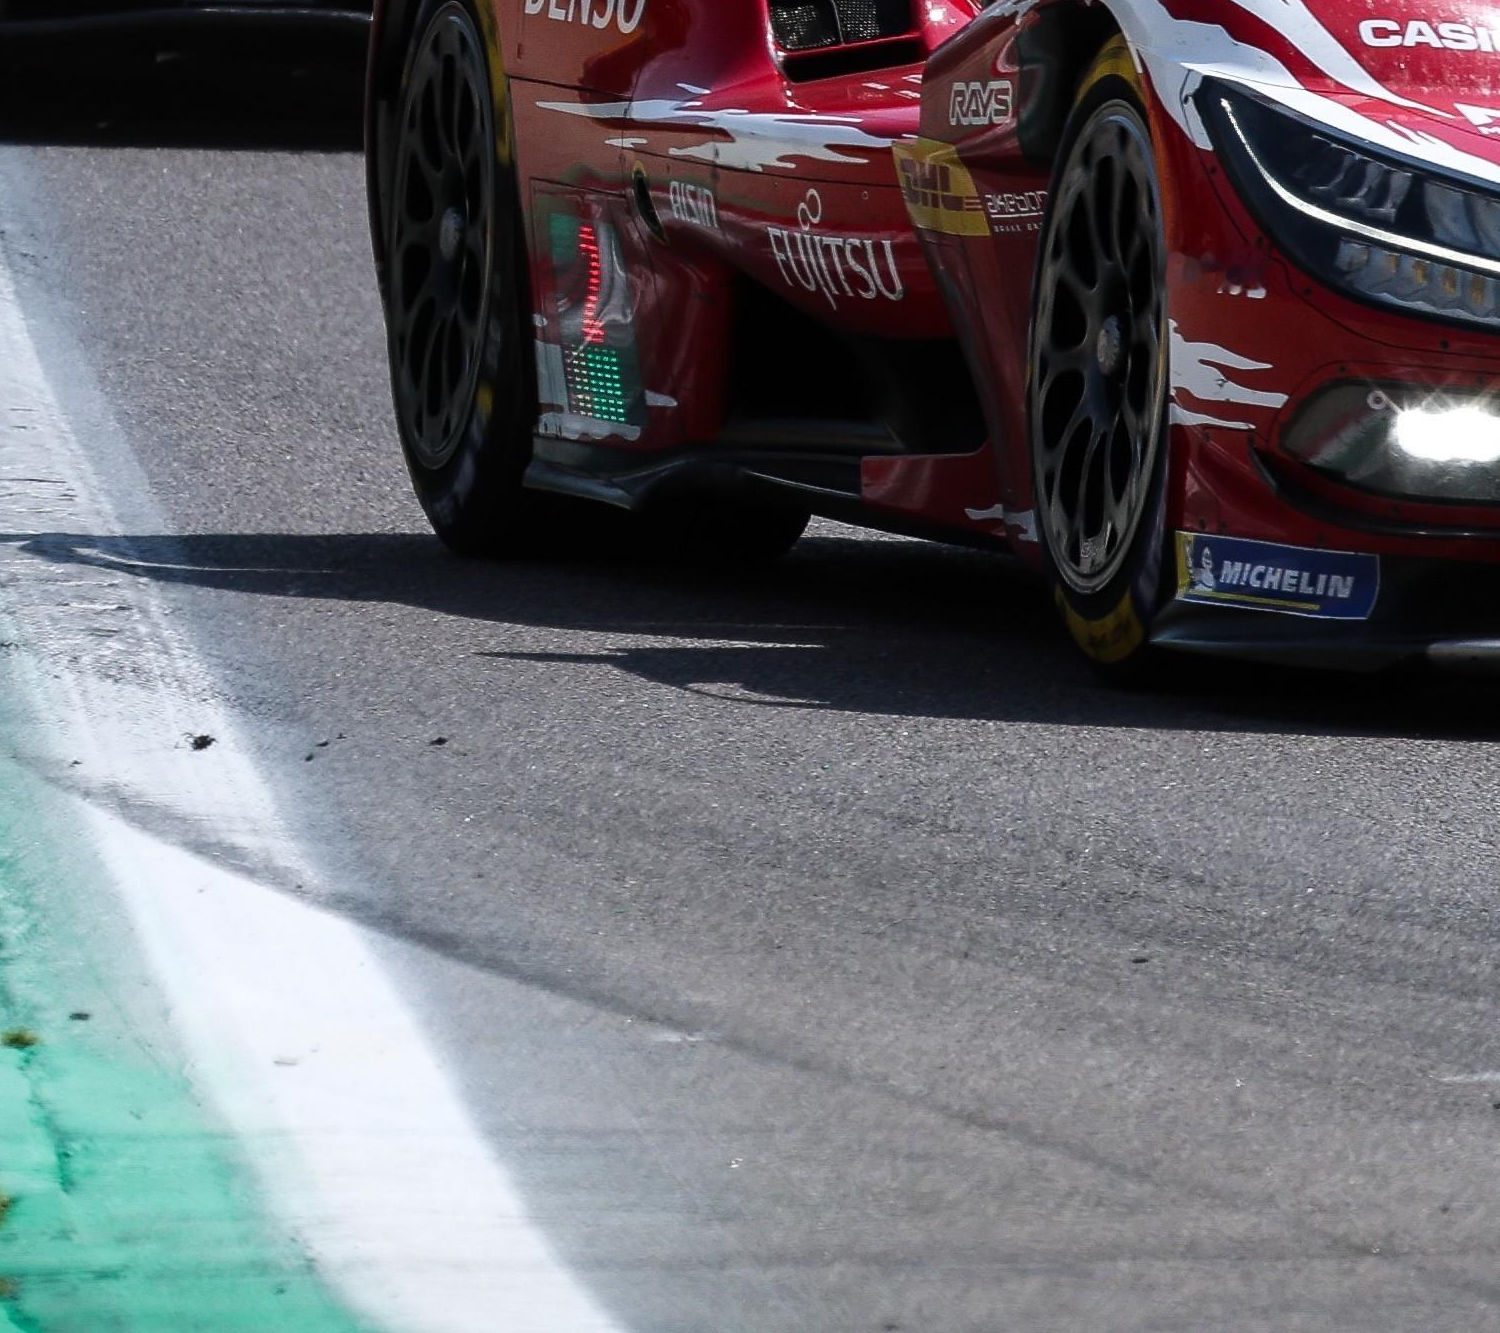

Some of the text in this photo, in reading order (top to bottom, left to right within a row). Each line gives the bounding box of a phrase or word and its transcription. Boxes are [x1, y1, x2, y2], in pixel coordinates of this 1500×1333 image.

[949, 80, 1013, 126] RAYS
[767, 227, 905, 311] FUJITSU
[1219, 560, 1355, 599] MICHELIN
